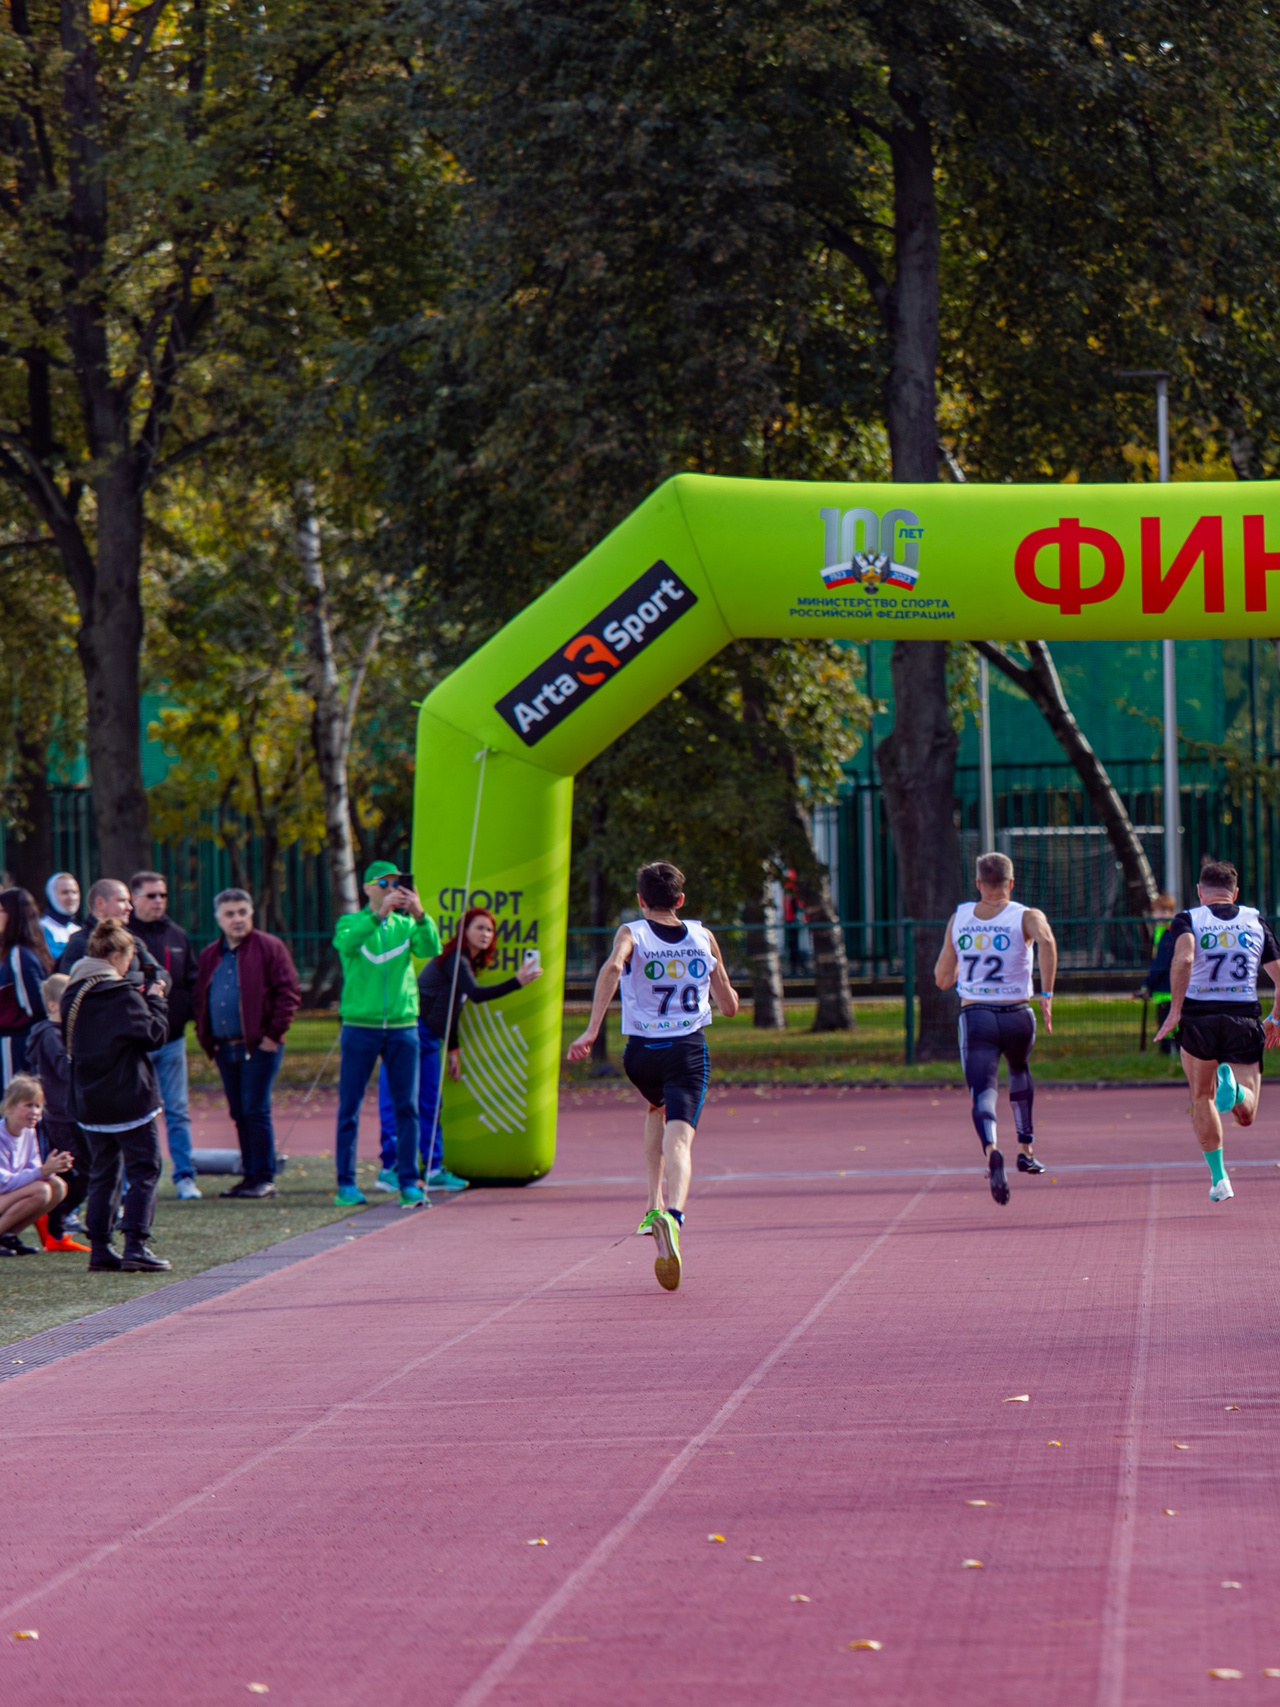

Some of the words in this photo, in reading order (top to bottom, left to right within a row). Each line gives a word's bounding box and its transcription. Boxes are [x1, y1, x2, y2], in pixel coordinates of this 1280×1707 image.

[899, 528, 924, 539] ЛЕТ
[789, 607, 873, 619] РОССИЙСКОЙ
[876, 610, 956, 620] ФЕДЕРАЦИИ
[797, 597, 898, 609] МИНИСТЕРСТВО
[901, 598, 950, 609] СПОРТА
[512, 672, 579, 734] Arta
[602, 578, 685, 652] Sport
[438, 887, 524, 915] СПОРТ
[439, 914, 539, 944] НМА
[643, 948, 707, 960] VMARAFONE
[1205, 952, 1249, 983] 73
[962, 954, 1005, 984] 72
[652, 983, 700, 1017] 70
